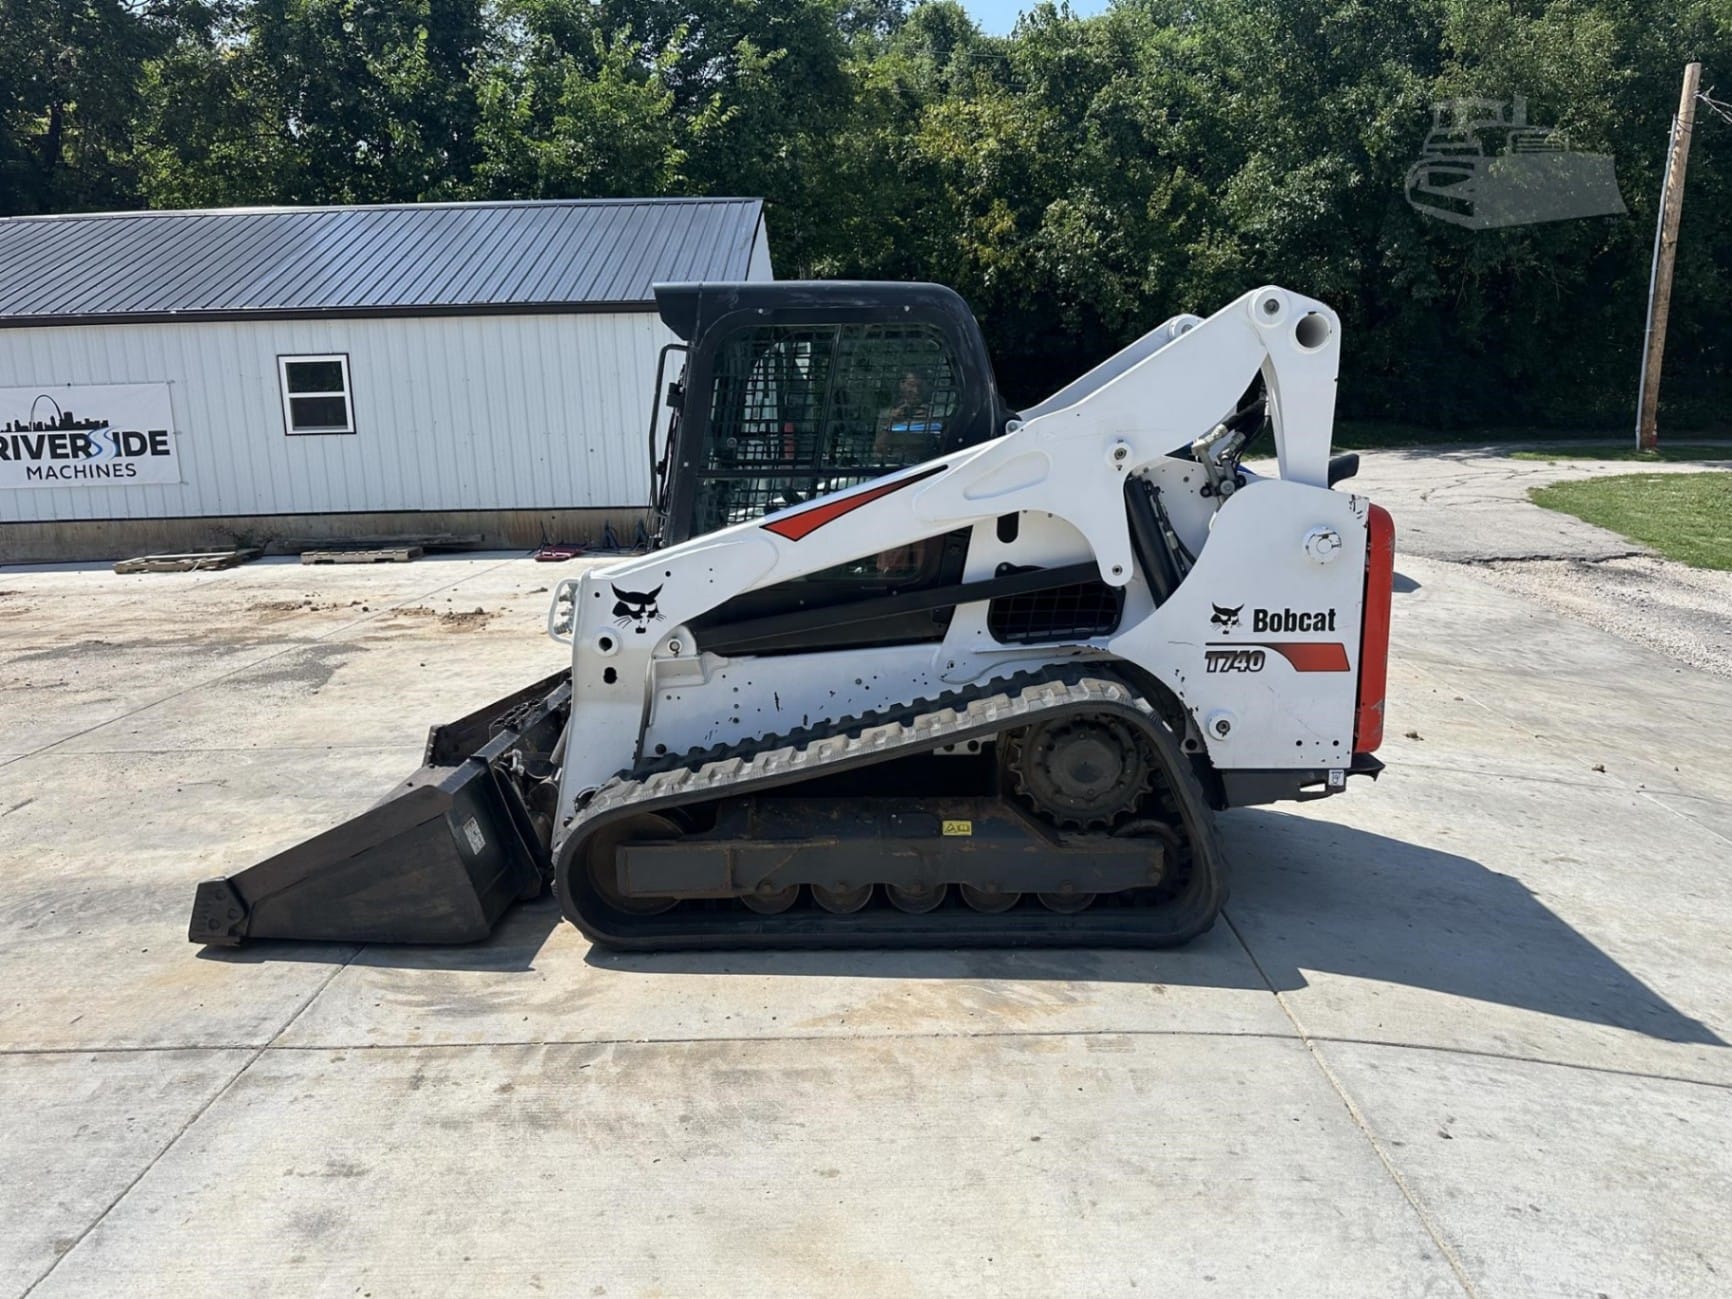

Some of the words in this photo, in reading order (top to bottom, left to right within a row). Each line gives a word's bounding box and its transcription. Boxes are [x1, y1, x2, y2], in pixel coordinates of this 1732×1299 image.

[26, 463, 137, 480] MACHINES
[1253, 608, 1336, 633] Bobcat
[1205, 650, 1266, 673] T740
